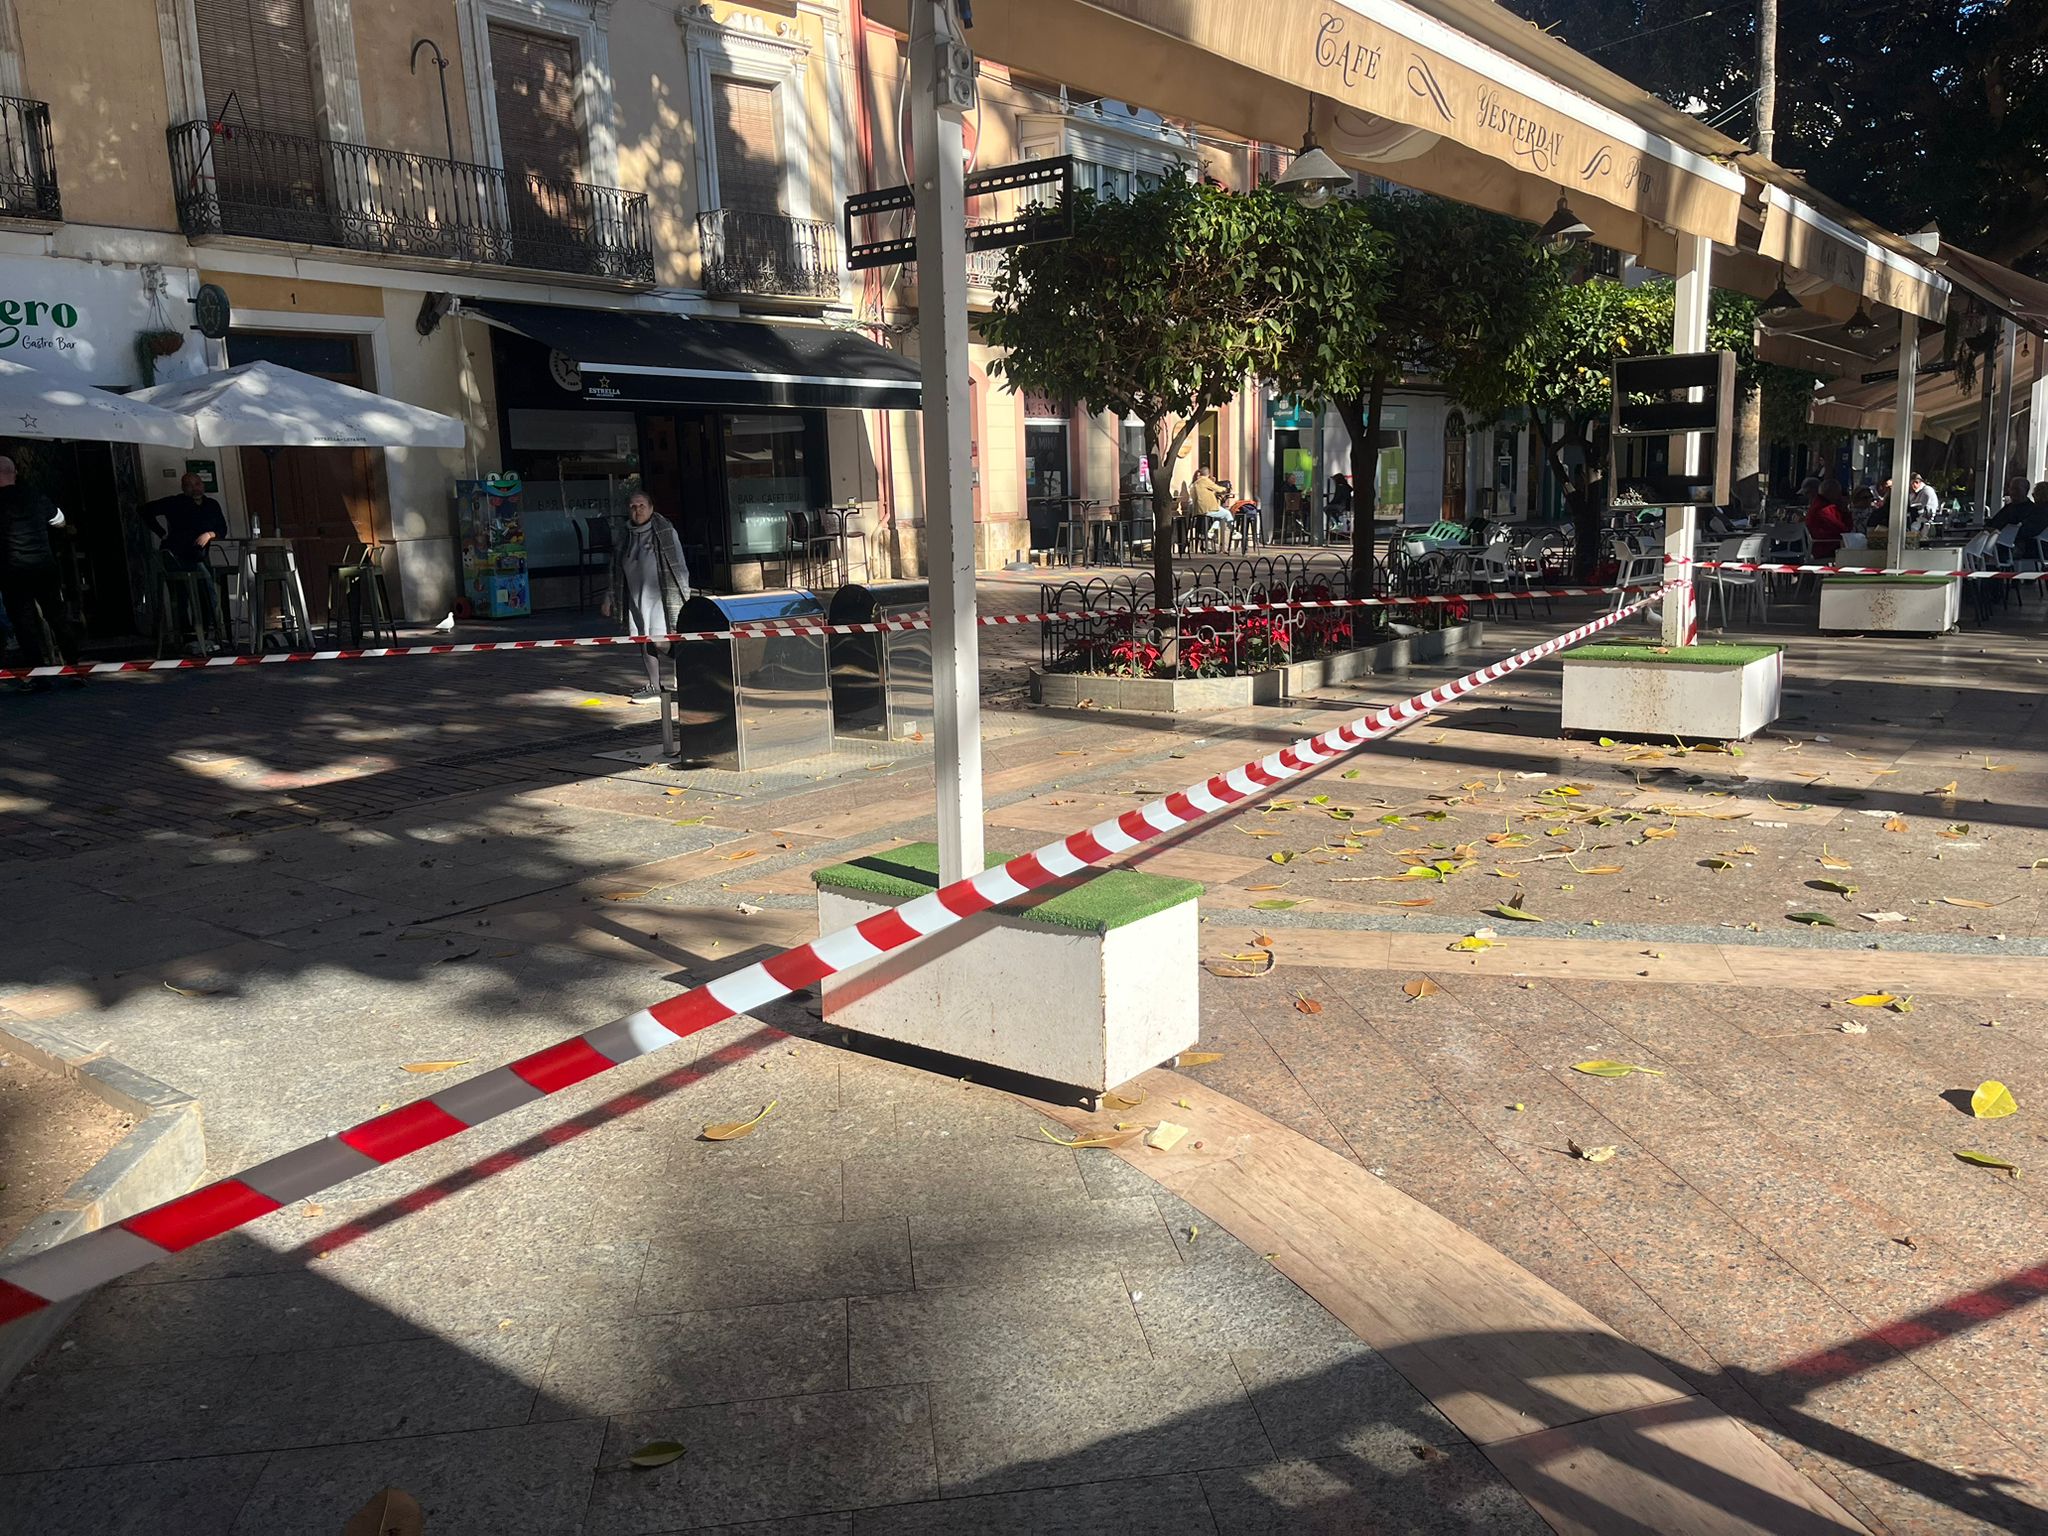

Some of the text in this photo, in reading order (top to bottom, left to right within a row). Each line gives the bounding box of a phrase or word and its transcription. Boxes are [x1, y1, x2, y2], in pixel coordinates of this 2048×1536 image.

[290, 293, 296, 304] 1
[22, 335, 76, 350] Gastro Bar
[588, 387, 621, 395] ESTRELLA
